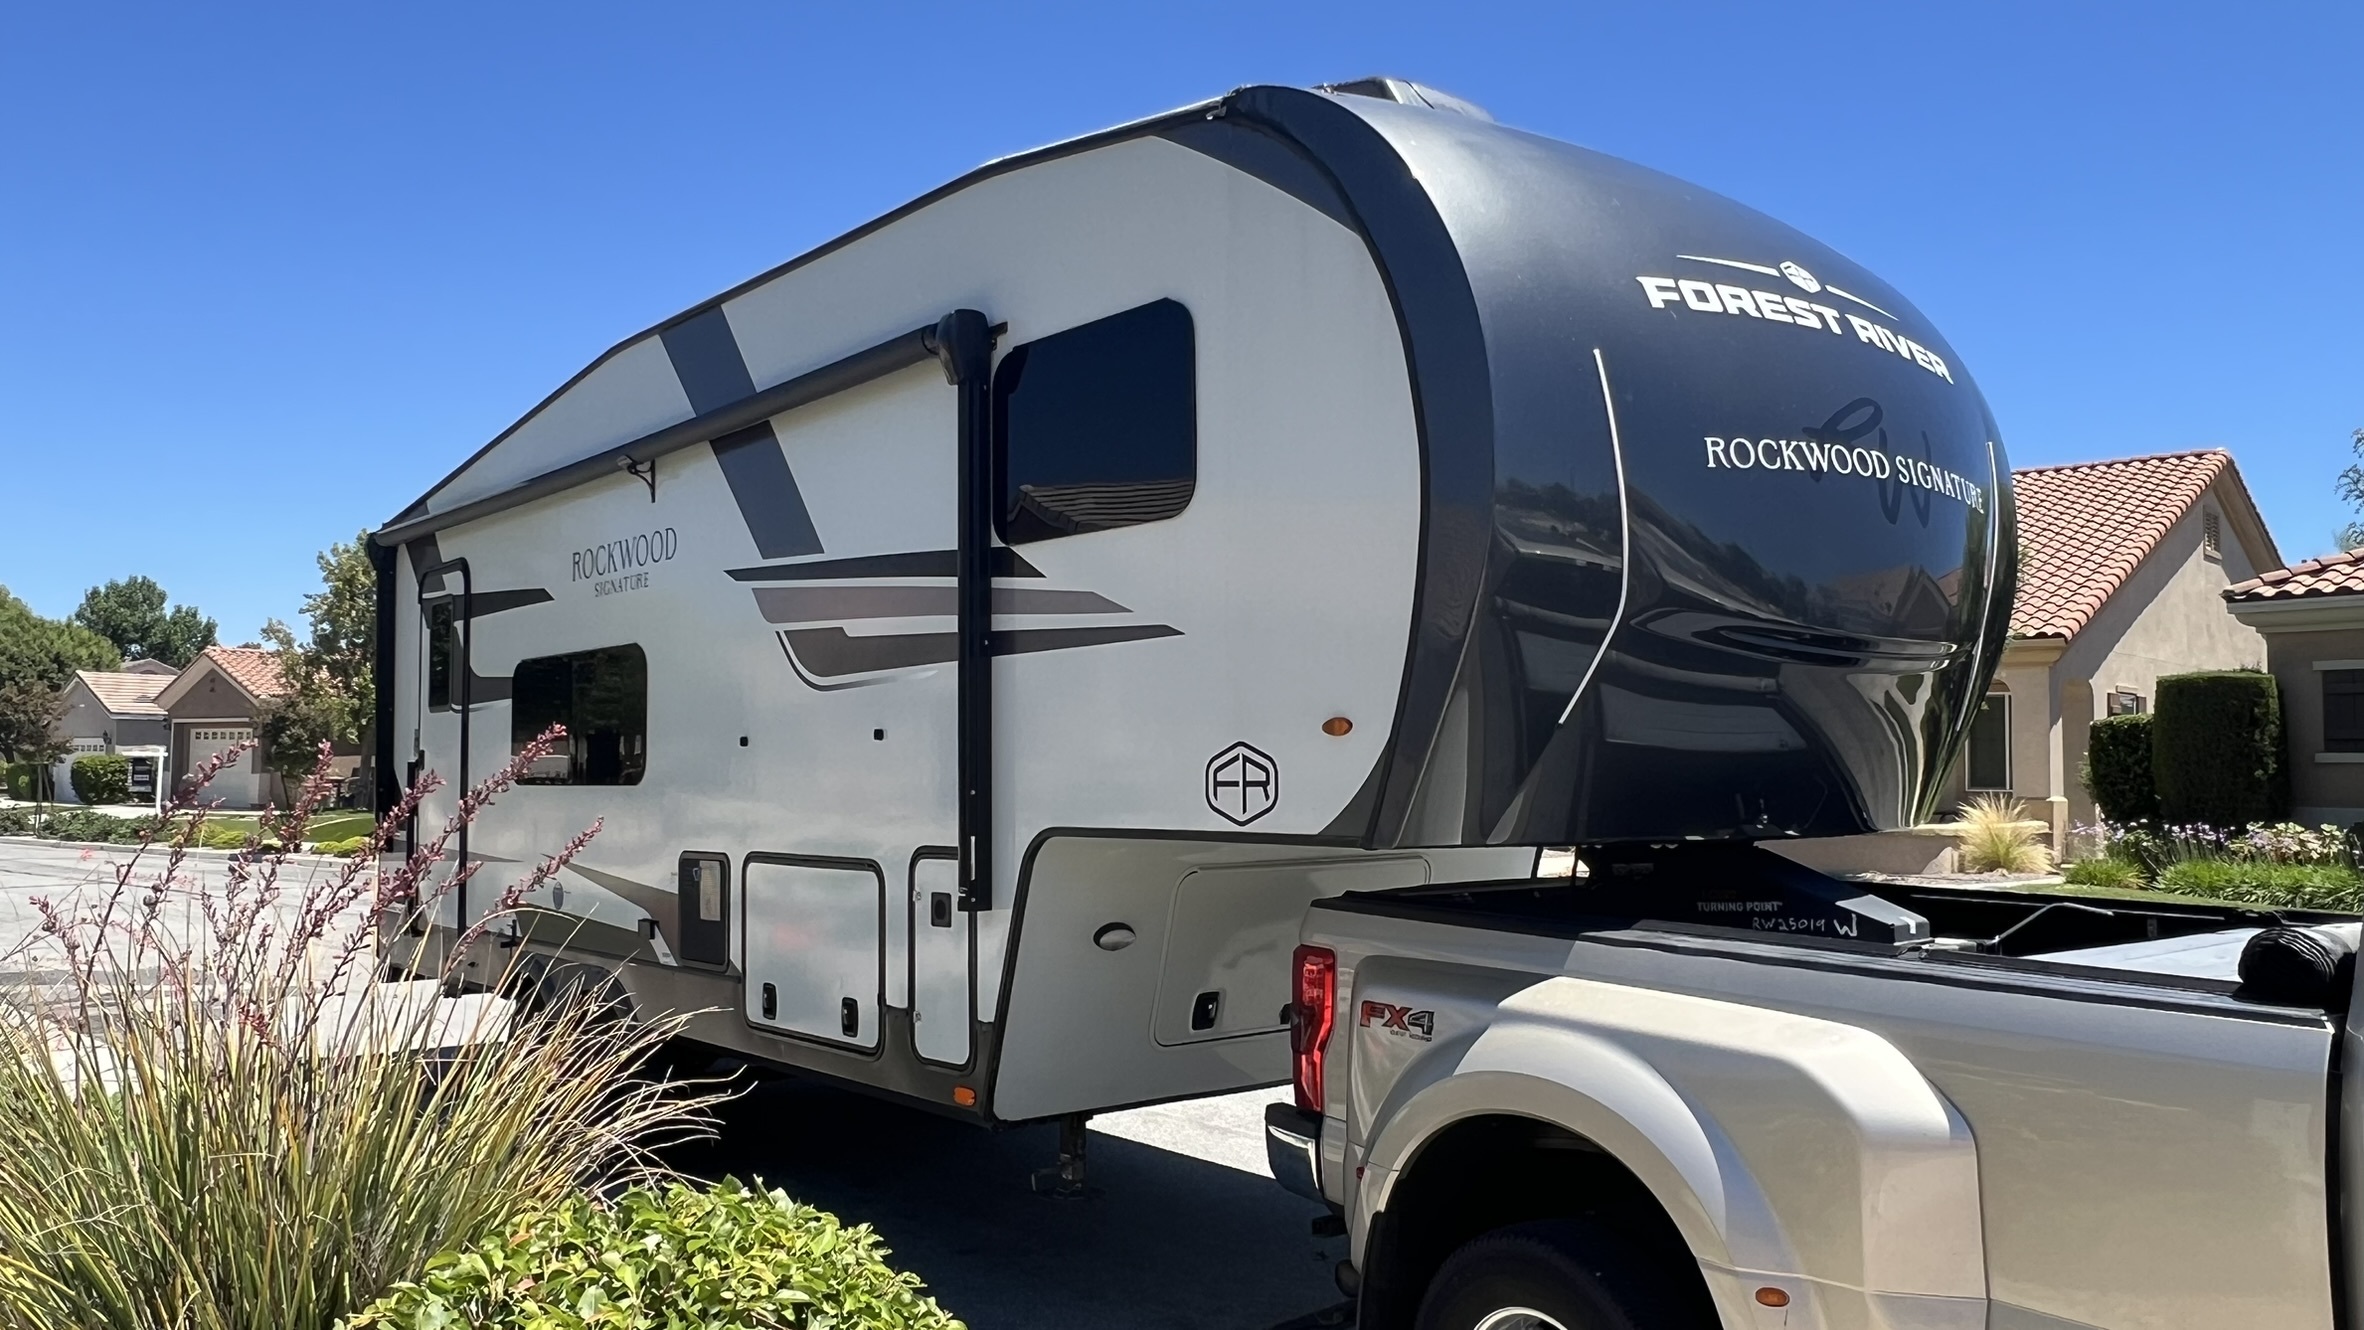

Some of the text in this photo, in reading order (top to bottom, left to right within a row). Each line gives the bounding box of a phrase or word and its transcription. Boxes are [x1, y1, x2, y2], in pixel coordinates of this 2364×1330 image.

[1636, 276, 1842, 335] FOREST
[1844, 313, 1954, 385] RIVER
[1704, 437, 1984, 515] ROCKWOOD SIGNATURE
[572, 527, 677, 582] ROCKWOOD
[594, 571, 649, 598] SIGNATURE
[1697, 901, 1783, 912] TURNING POINT
[1752, 913, 1858, 937] RW25019 W
[1360, 1000, 1435, 1035] FX4
